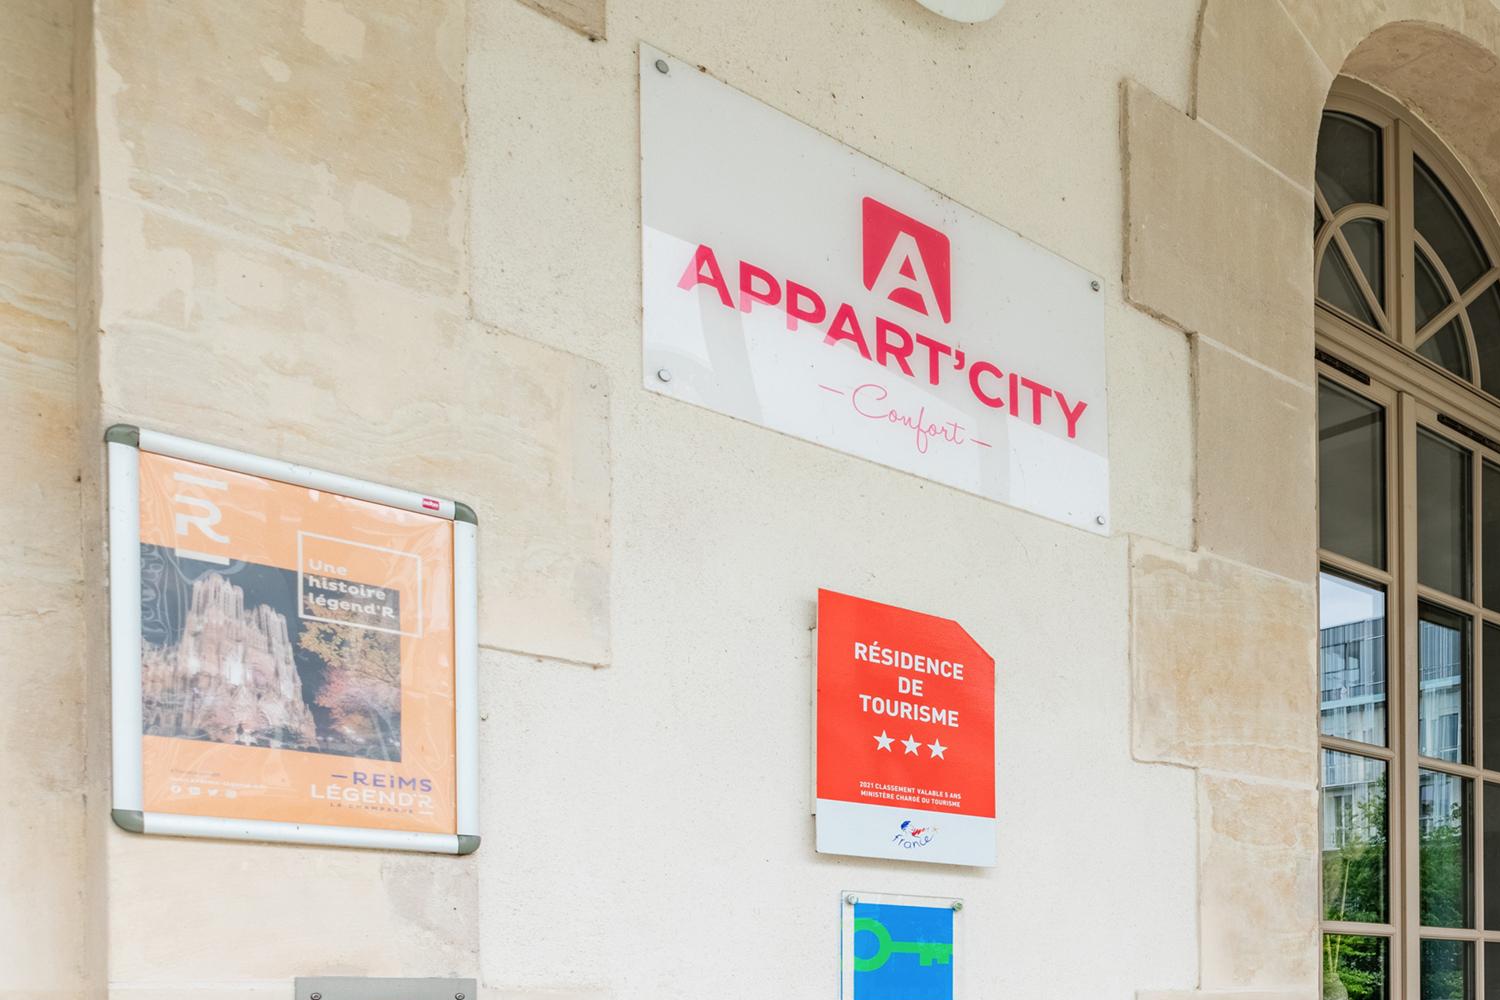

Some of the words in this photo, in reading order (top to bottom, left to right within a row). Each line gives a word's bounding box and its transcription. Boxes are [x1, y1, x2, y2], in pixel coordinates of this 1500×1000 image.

[676, 243, 1088, 439] APPART'CITY
[852, 384, 964, 453] Confort
[308, 559, 348, 576] Une
[308, 575, 386, 600] histoire
[308, 592, 395, 618] légend'R
[854, 641, 964, 681] RÉSIDENCE
[898, 676, 924, 697] DE
[859, 694, 959, 728] TOURISME
[861, 790, 895, 800] MINISTÈRE
[931, 798, 960, 807] TOURISME
[875, 782, 915, 794] CLASSEMENT
[917, 788, 943, 798] VALABLE
